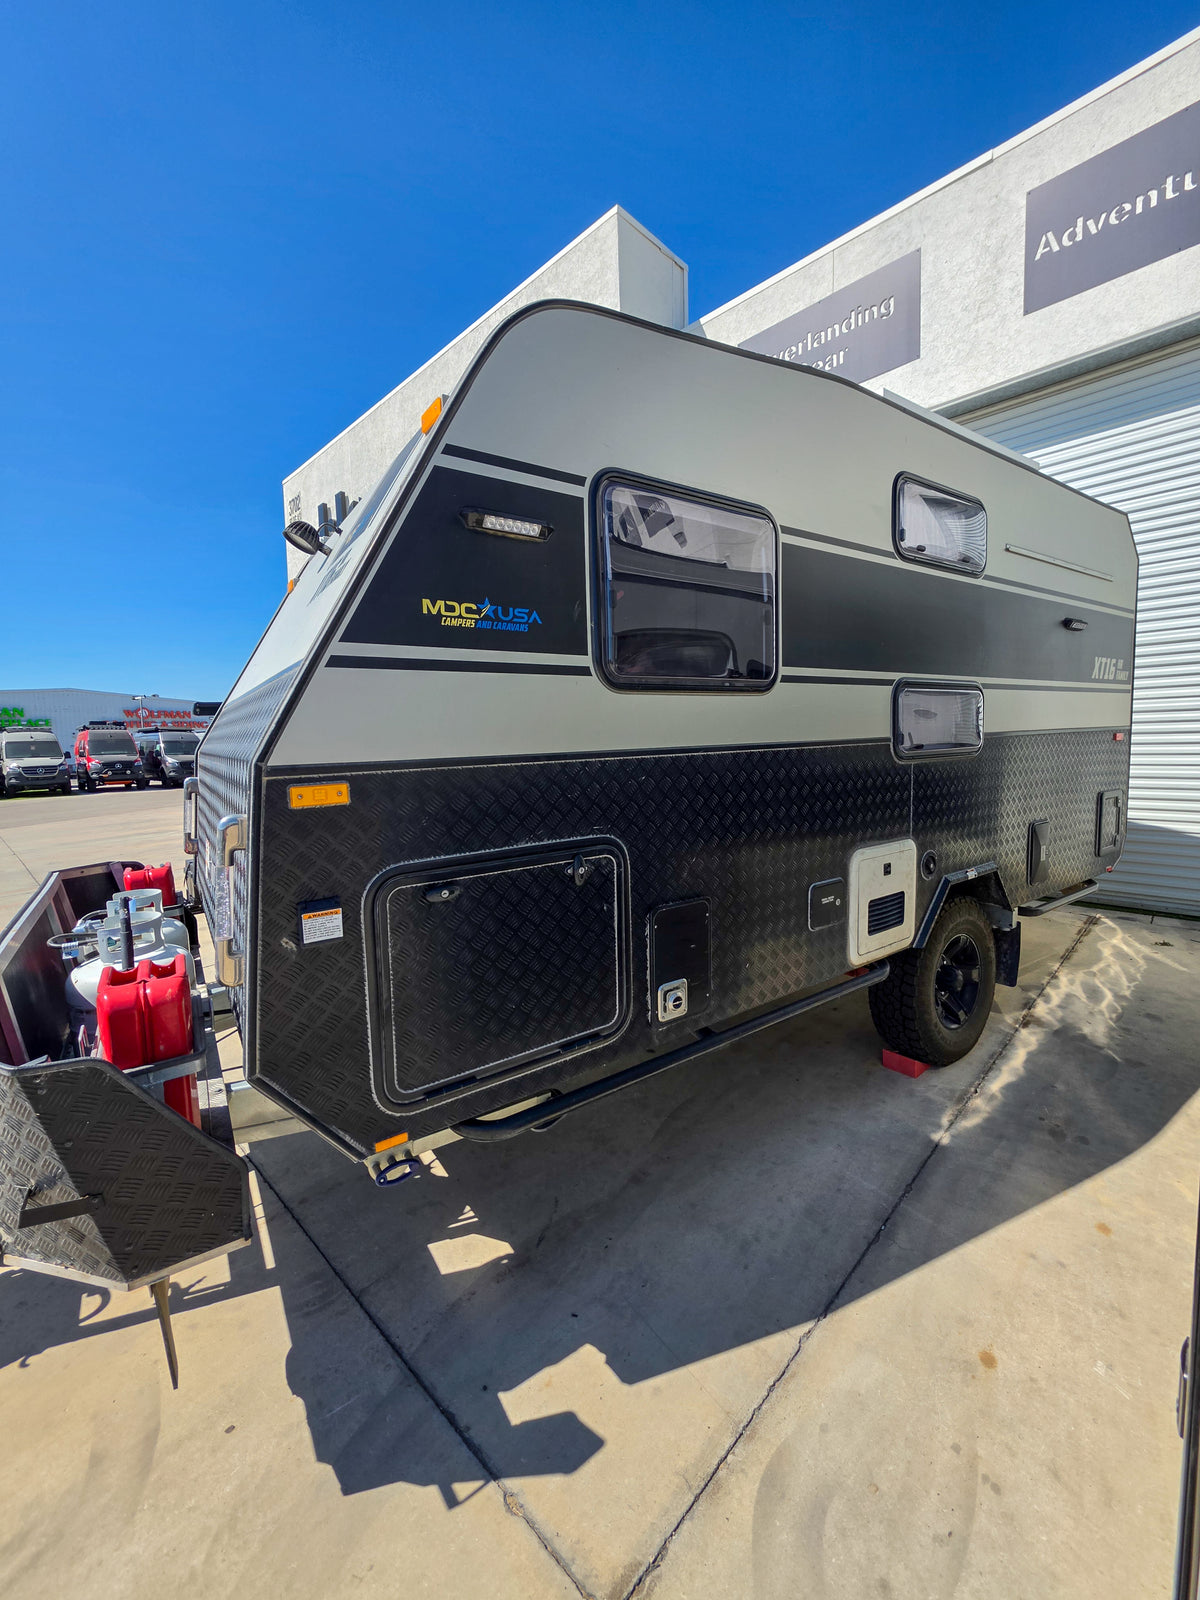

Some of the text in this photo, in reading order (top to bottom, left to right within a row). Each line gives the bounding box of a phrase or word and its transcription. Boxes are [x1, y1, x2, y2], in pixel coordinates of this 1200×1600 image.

[802, 347, 849, 371] ear
[421, 598, 543, 625] MDC USA
[441, 616, 529, 632] CAMPERS AND CARAVANS
[1091, 656, 1117, 680] XT16
[122, 707, 192, 719] WOLFMAN
[312, 910, 338, 918] WARNING
